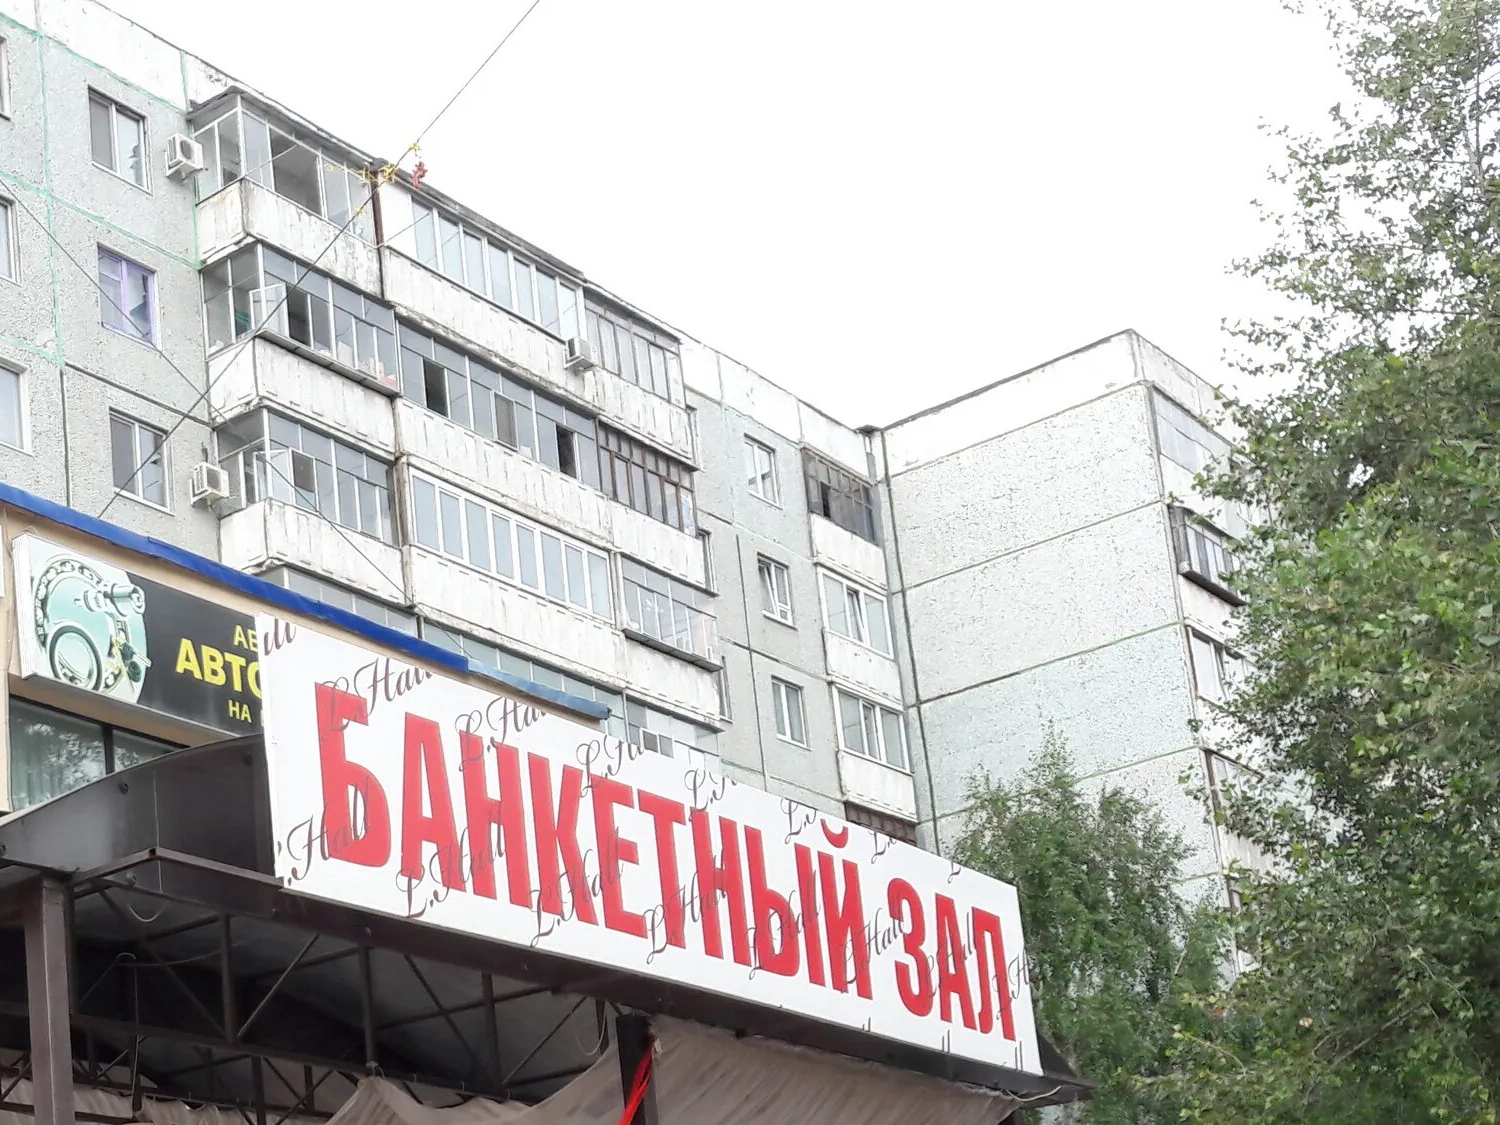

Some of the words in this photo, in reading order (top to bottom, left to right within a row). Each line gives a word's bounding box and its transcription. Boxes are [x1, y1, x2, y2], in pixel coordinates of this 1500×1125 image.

[228, 699, 252, 723] НА
[315, 681, 873, 1001] БАНКЕТНЫЙ
[887, 877, 1017, 1041] ЗАЛ
